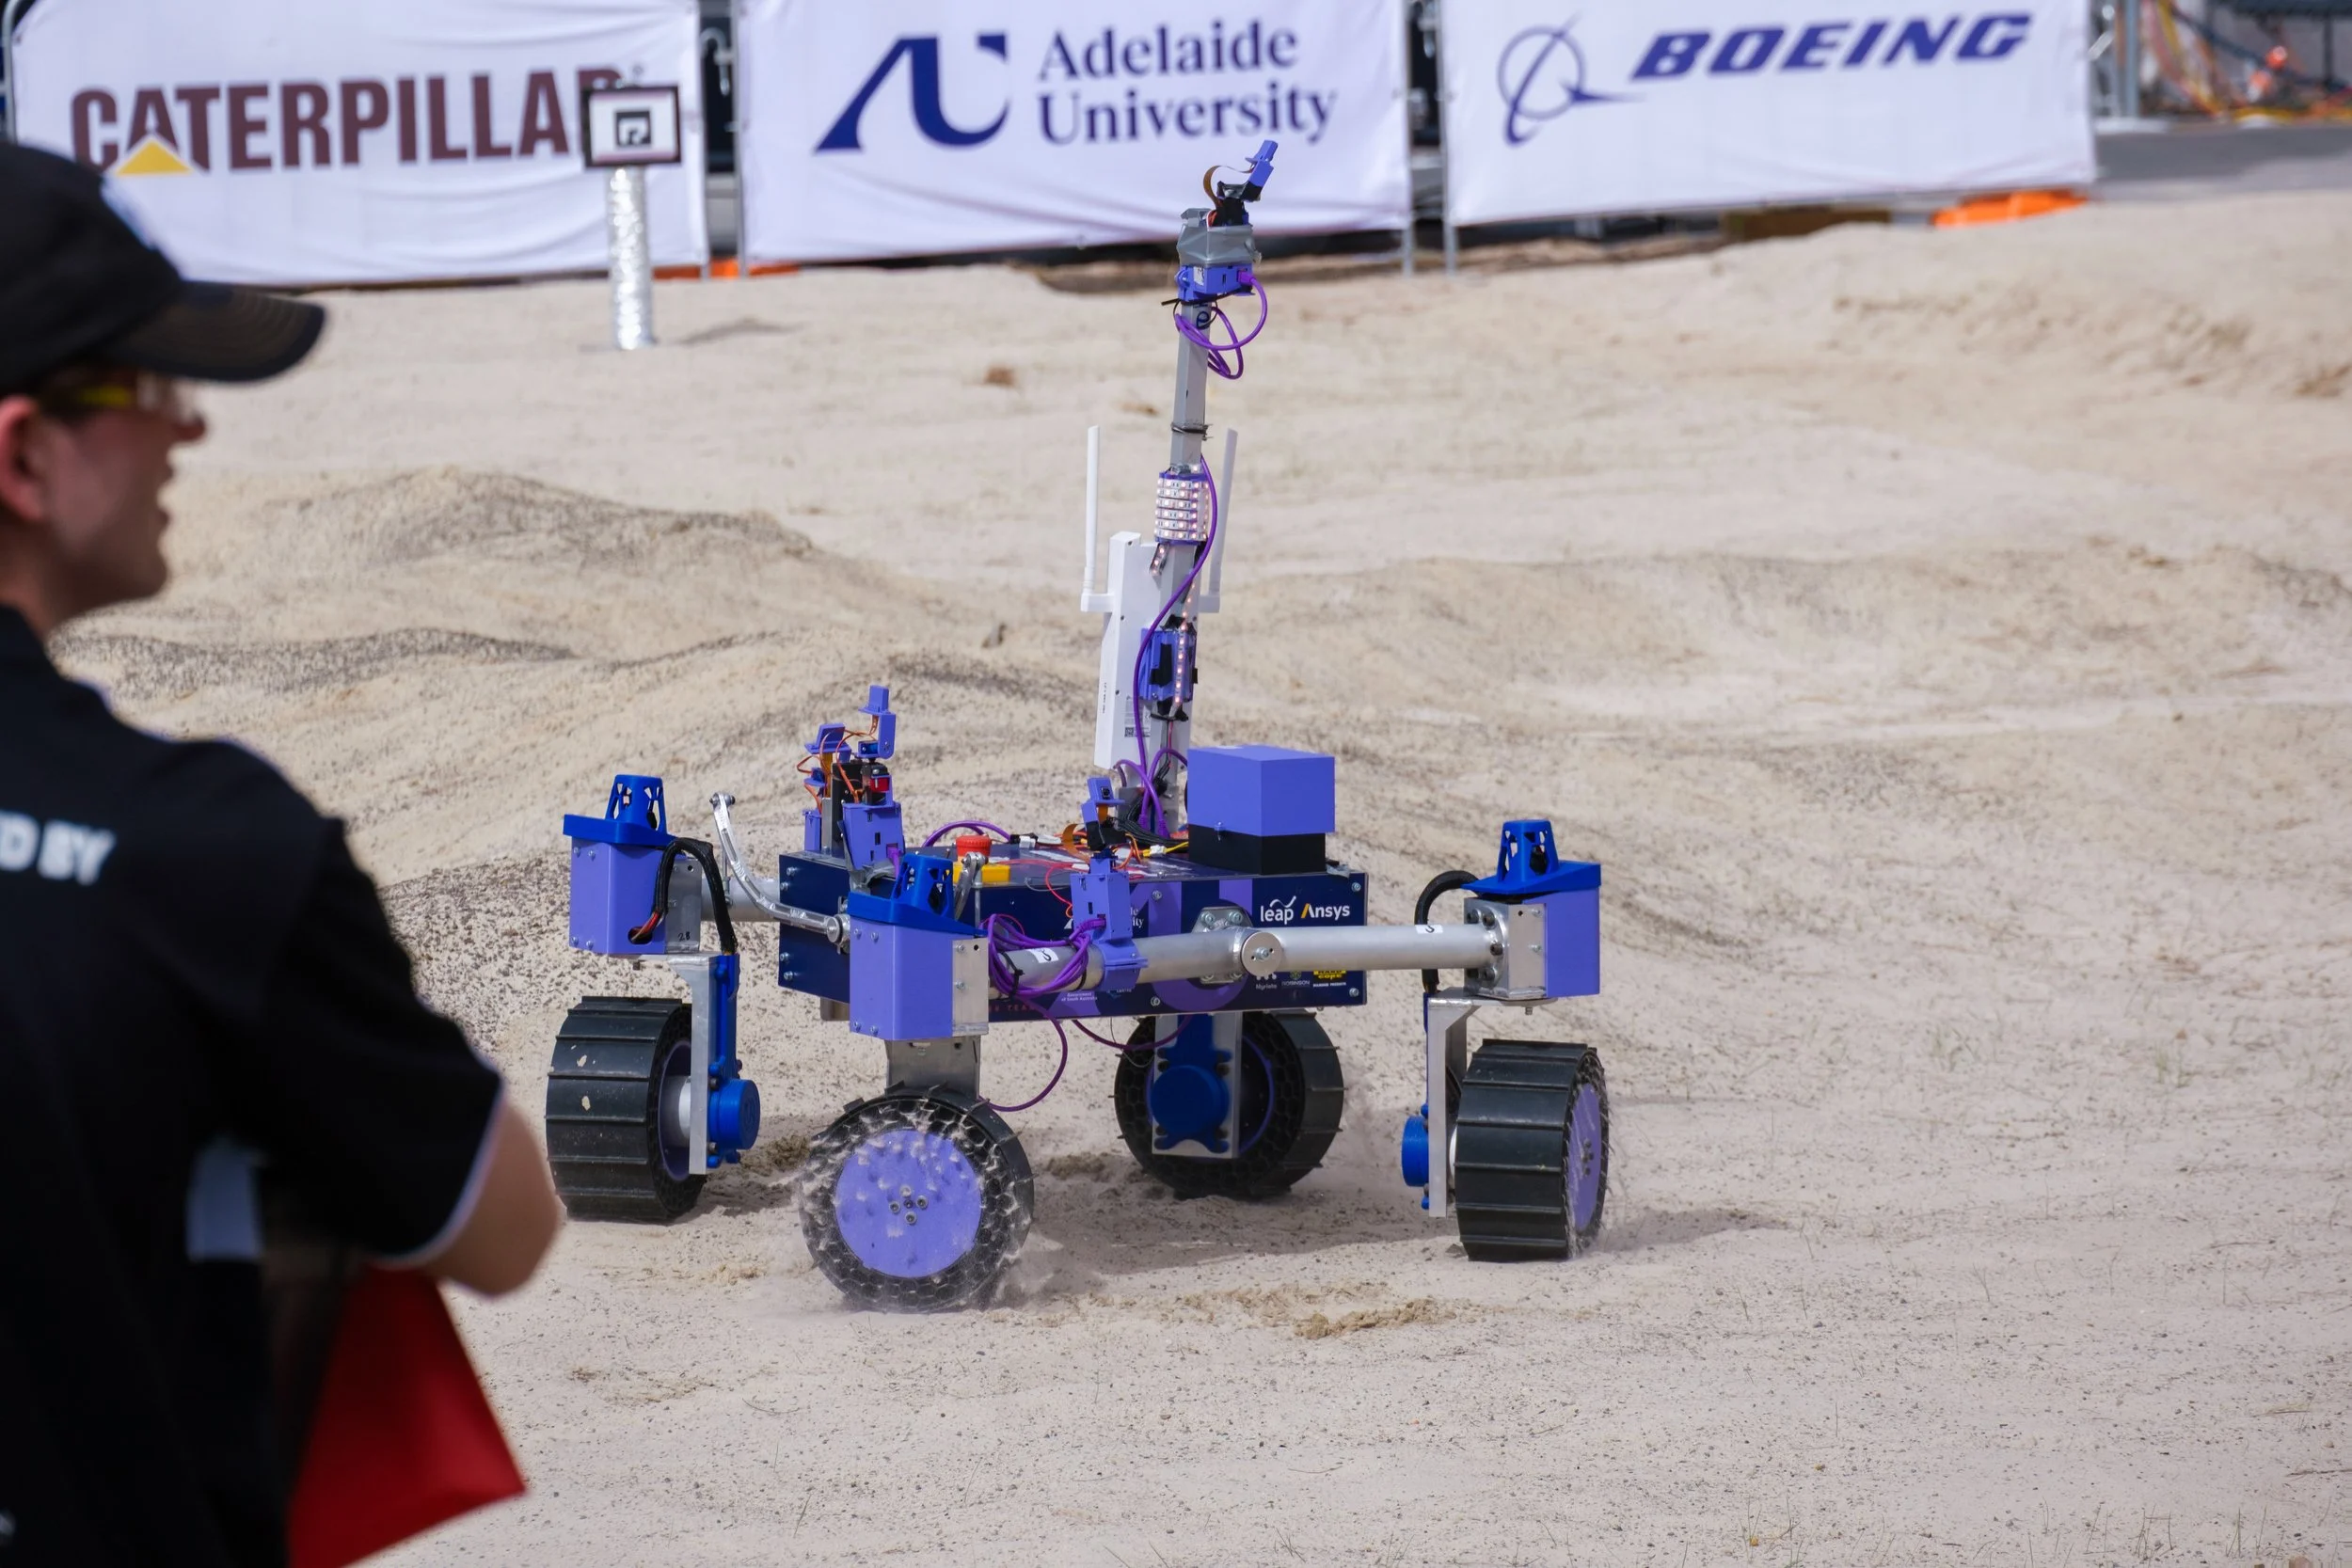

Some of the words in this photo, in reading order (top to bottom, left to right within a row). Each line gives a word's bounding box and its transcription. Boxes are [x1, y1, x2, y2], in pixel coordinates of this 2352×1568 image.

[1038, 19, 1299, 81] Adelaide
[1629, 11, 2033, 82] BOEING
[71, 65, 623, 175] CATERPILLA
[1037, 79, 1337, 145] University
[38, 818, 117, 885] BY
[1261, 905, 1295, 925] leap
[1300, 903, 1350, 921] Ansys
